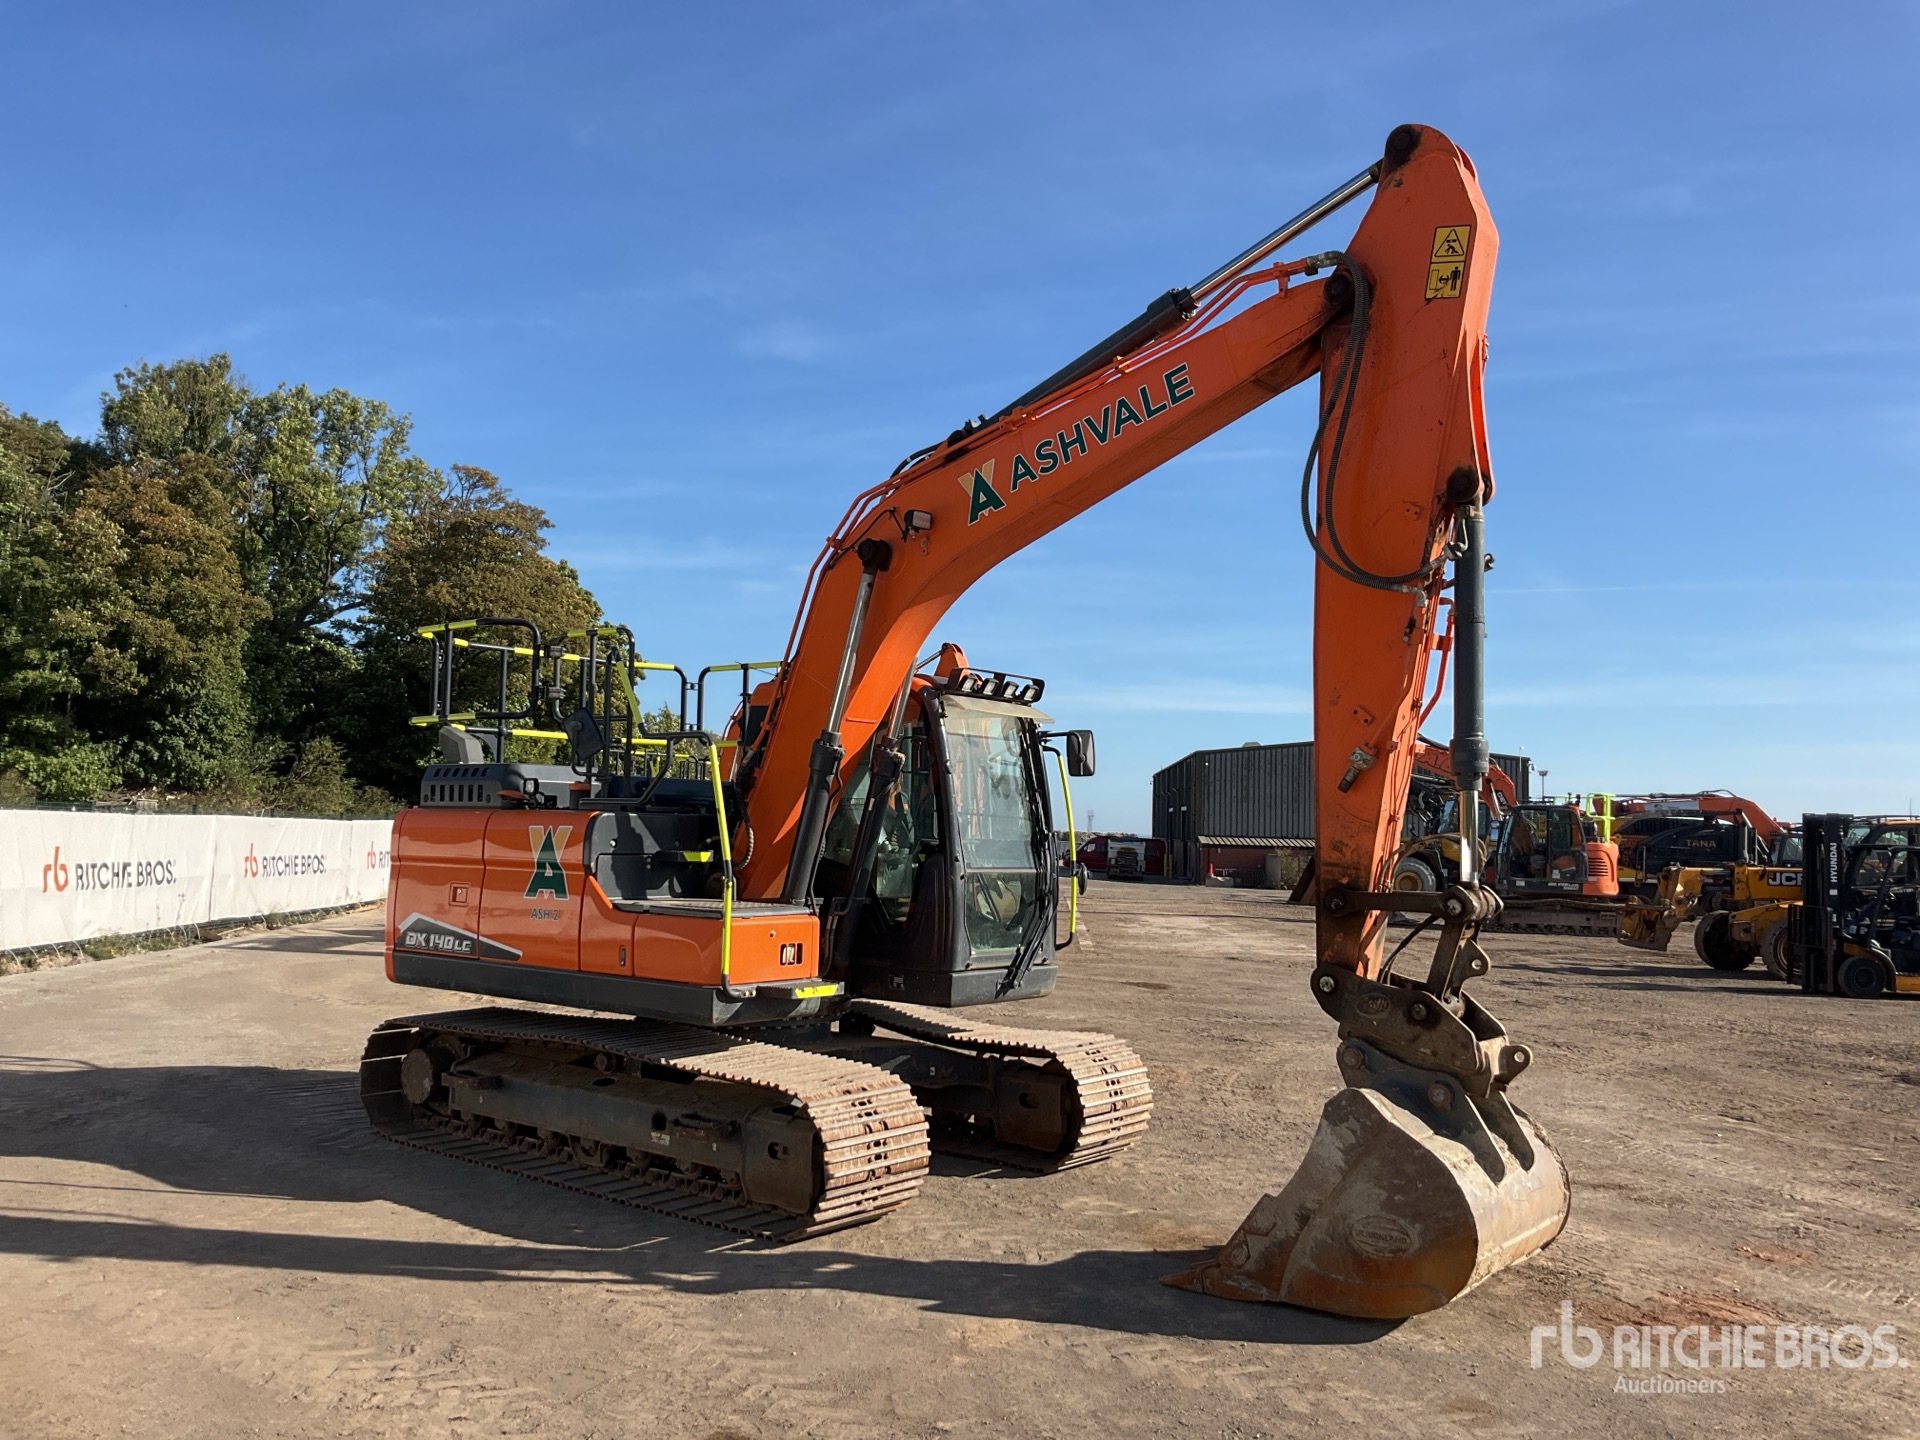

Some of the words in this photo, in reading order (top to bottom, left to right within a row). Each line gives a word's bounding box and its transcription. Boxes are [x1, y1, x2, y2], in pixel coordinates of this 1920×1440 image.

[1010, 361, 1196, 493] ASHVALE
[243, 843, 259, 878] rb
[262, 855, 299, 877] RITCHIE
[1685, 839, 1717, 848] TANA
[43, 846, 69, 893] rb
[75, 862, 133, 891] RITCHIE
[1829, 842, 1838, 883] HYUNDAI
[530, 907, 550, 919] ASH
[552, 909, 559, 921] 2
[405, 931, 427, 948] DX
